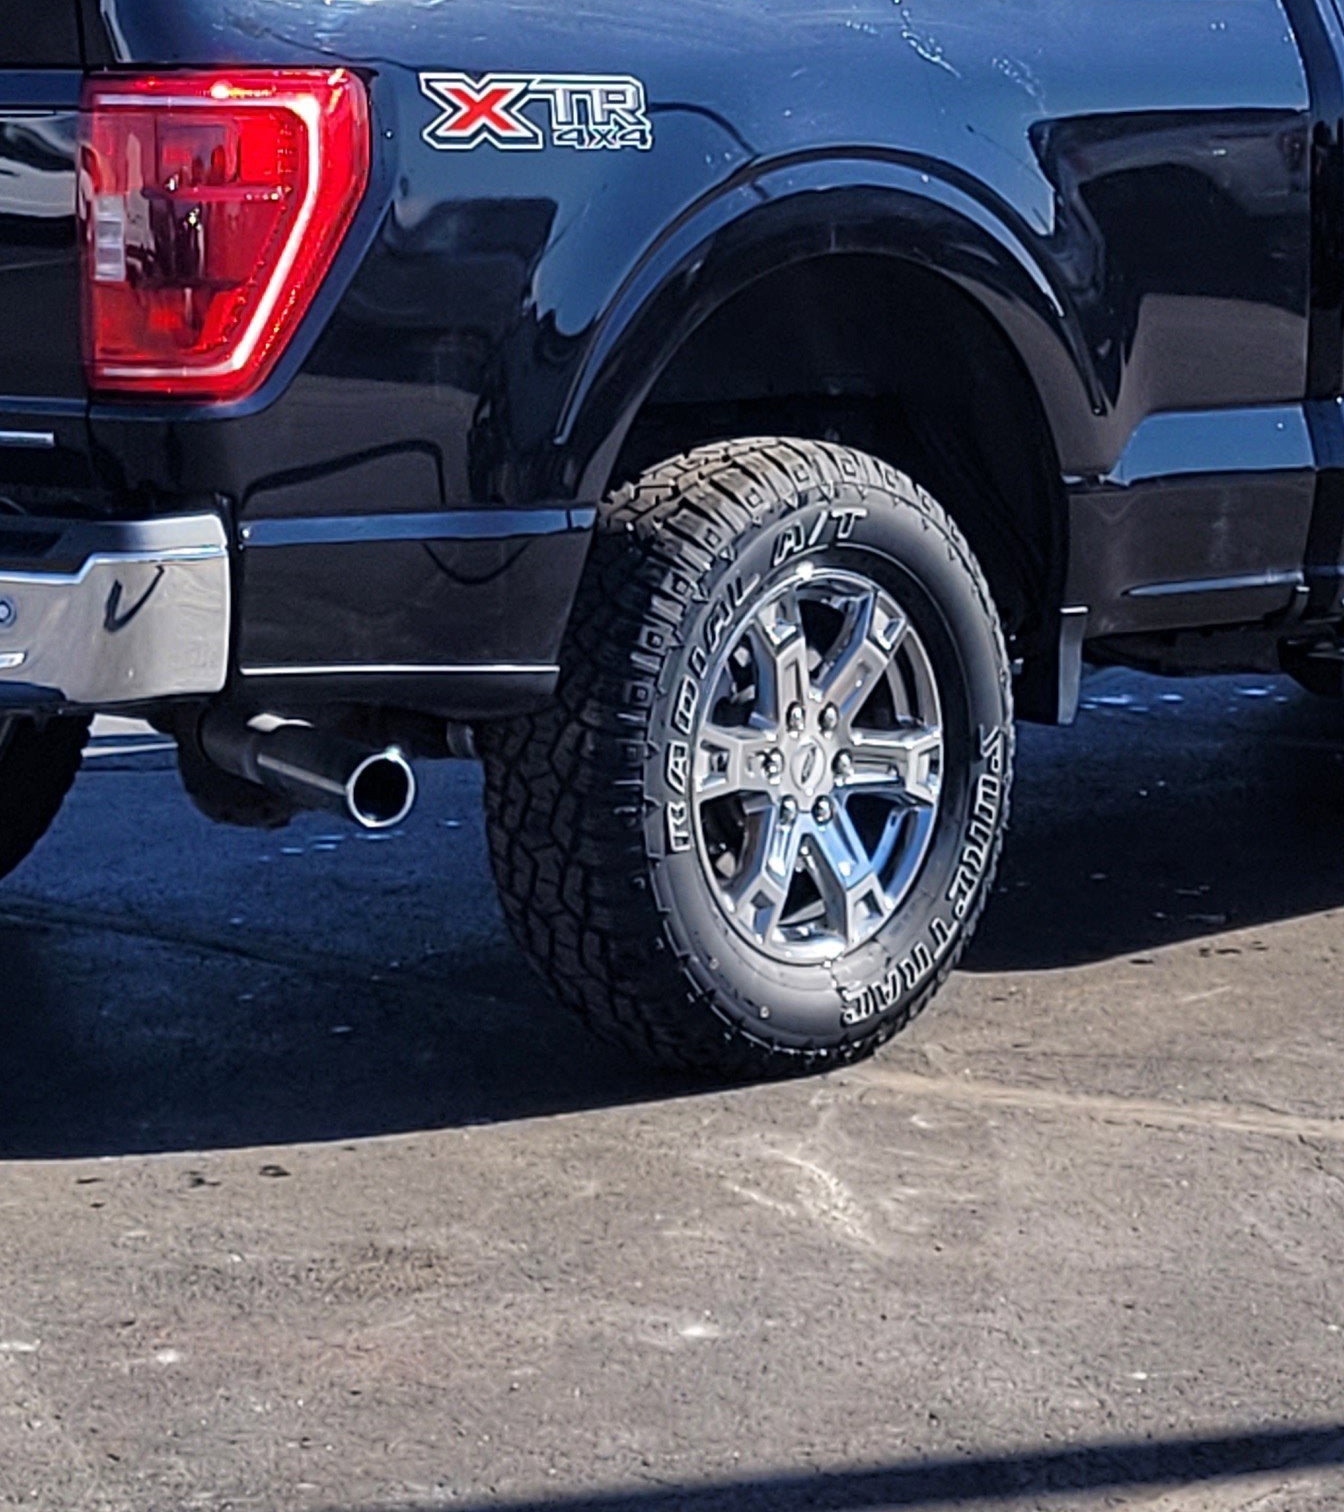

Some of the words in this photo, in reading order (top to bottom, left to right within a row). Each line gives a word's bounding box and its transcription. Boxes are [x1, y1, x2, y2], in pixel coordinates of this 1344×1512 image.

[419, 72, 646, 149] XTR
[666, 572, 761, 853] RADIAL
[773, 506, 867, 567] A/T
